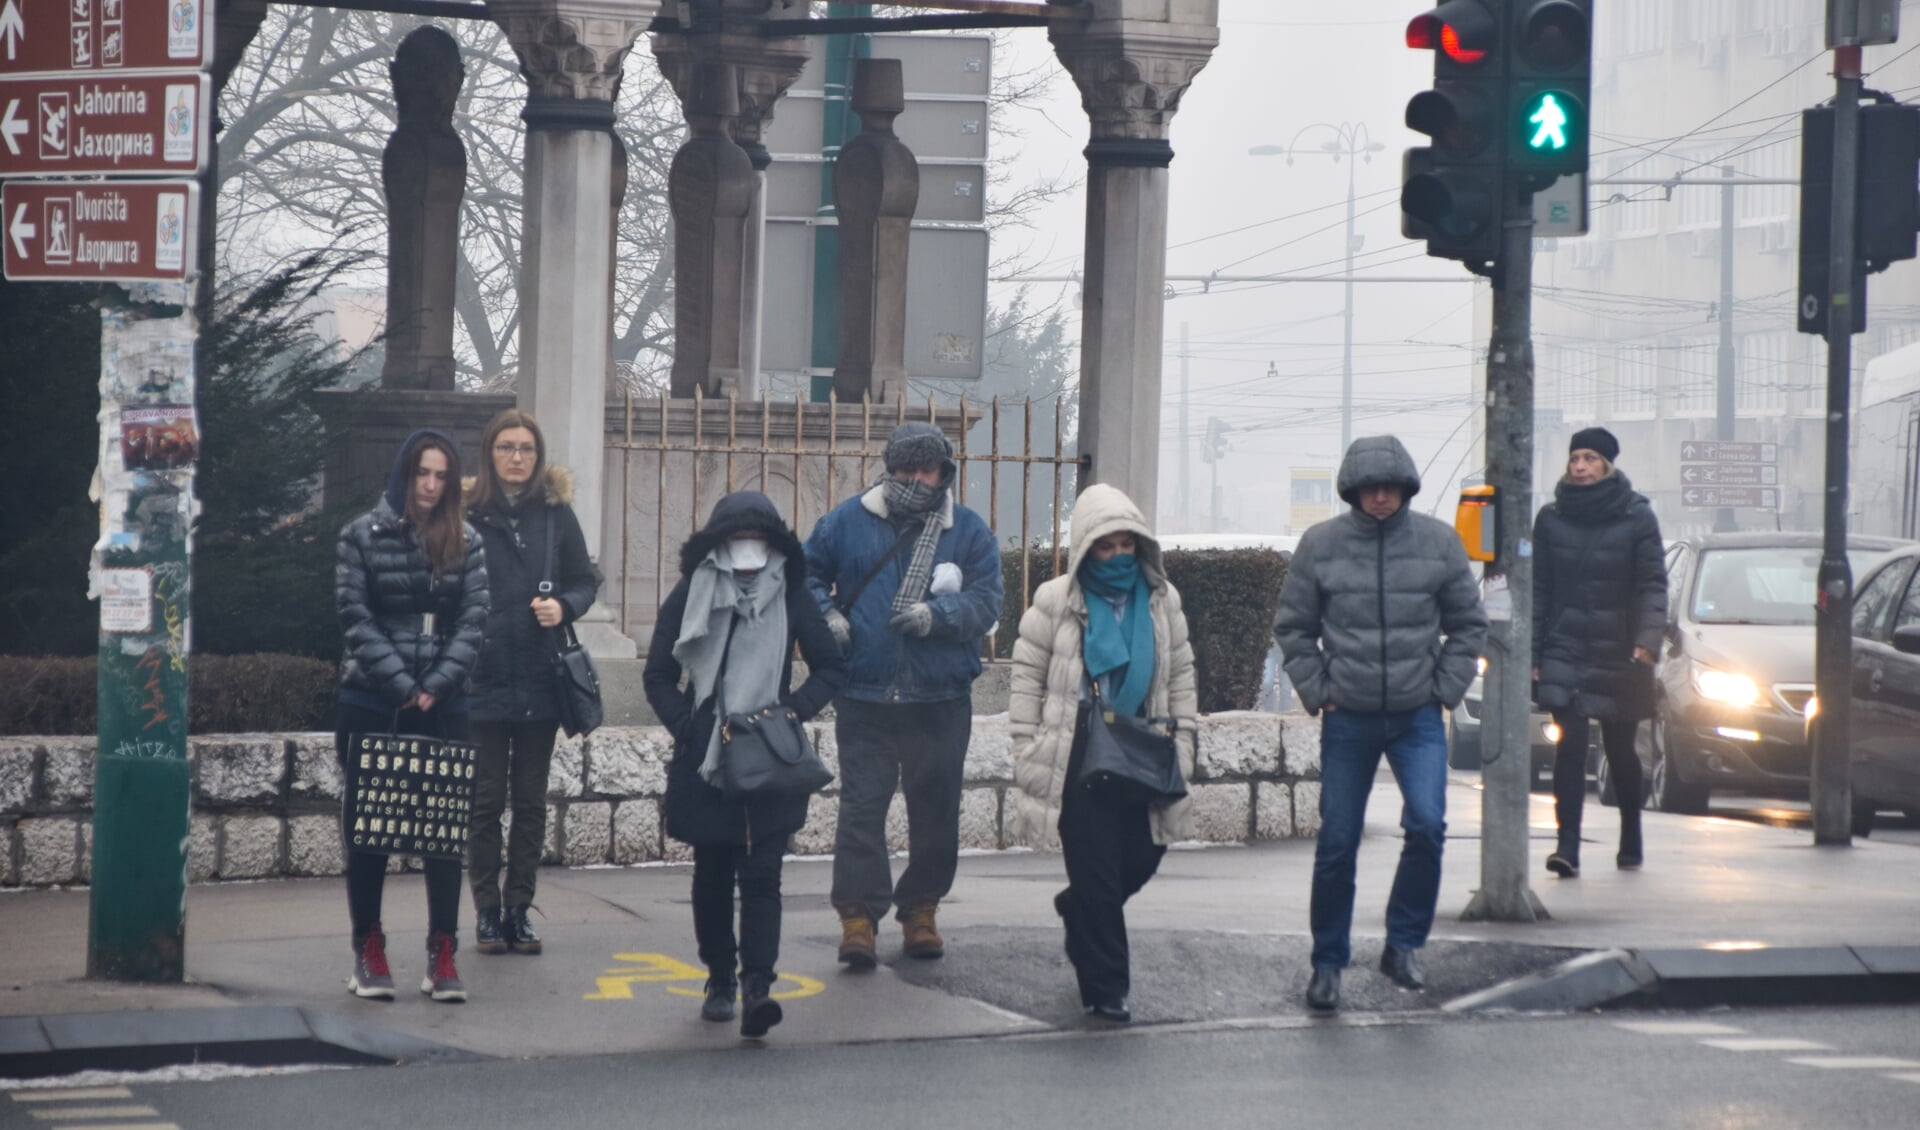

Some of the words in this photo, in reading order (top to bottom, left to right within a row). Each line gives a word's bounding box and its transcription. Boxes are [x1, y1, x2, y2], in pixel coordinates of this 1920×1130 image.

[74, 84, 146, 116] Jahorina
[74, 126, 153, 164] Јахорина
[76, 191, 127, 221] Dvorišta
[76, 232, 138, 271] Дворишта
[361, 753, 475, 779] ESPRESSO
[358, 776, 409, 789] LONG
[422, 782, 471, 796] BLACK
[356, 803, 405, 816] IRISH
[415, 809, 470, 824] COFFEE
[427, 796, 470, 811] MOCHA
[354, 817, 469, 841] AMERICANO
